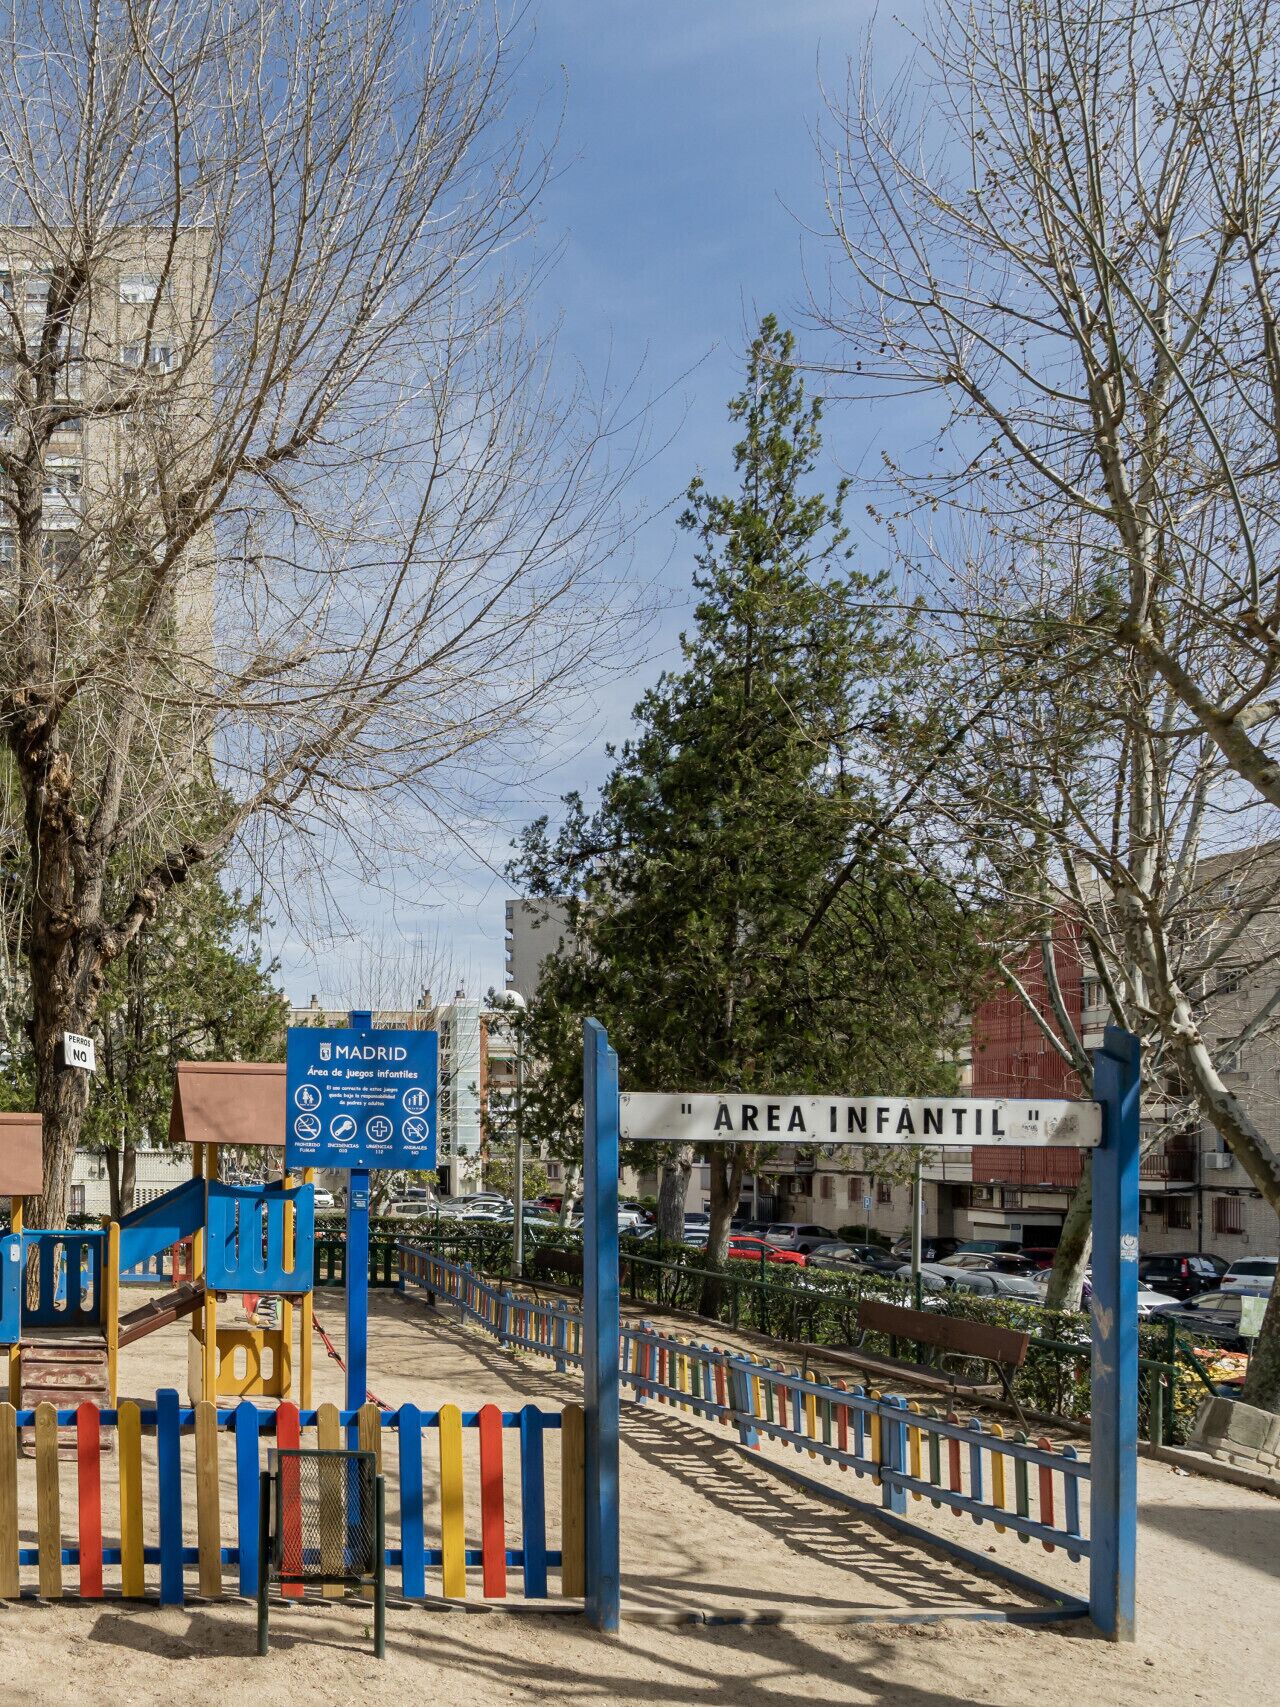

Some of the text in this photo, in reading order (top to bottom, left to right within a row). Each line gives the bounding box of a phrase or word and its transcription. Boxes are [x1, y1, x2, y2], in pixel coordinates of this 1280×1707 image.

[68, 1035, 91, 1047] PERROS
[73, 1048, 87, 1063] NO
[335, 1045, 407, 1061] MADRID
[307, 1065, 418, 1079] Área de juegos infantiles
